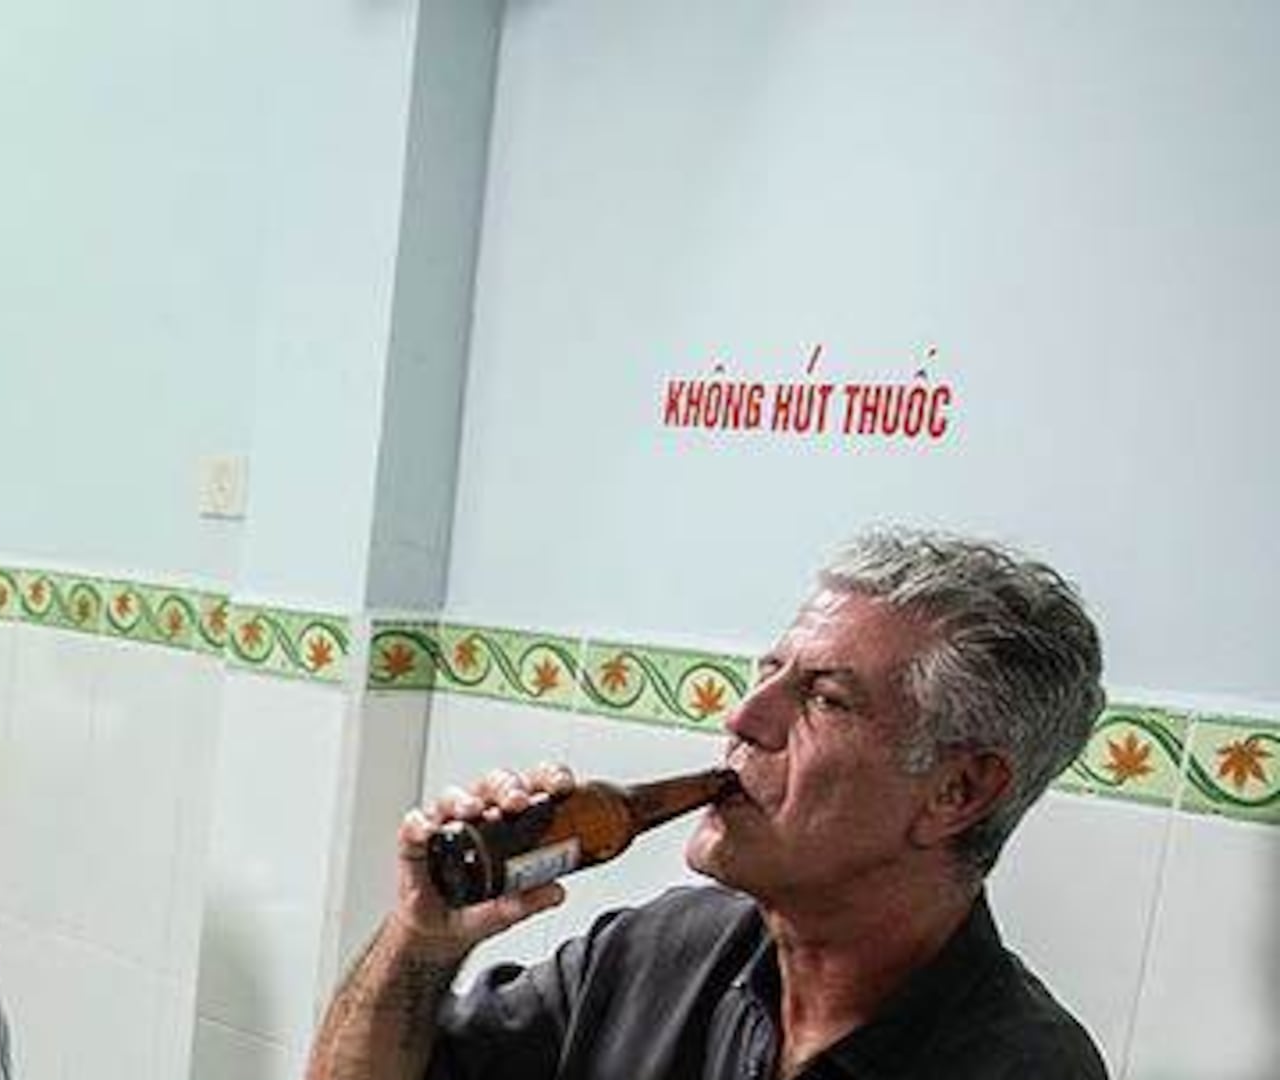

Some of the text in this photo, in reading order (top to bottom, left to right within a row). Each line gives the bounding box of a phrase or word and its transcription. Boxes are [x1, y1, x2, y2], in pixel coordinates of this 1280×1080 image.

[663, 345, 951, 438] KHÔNG HÚT THUỐC
